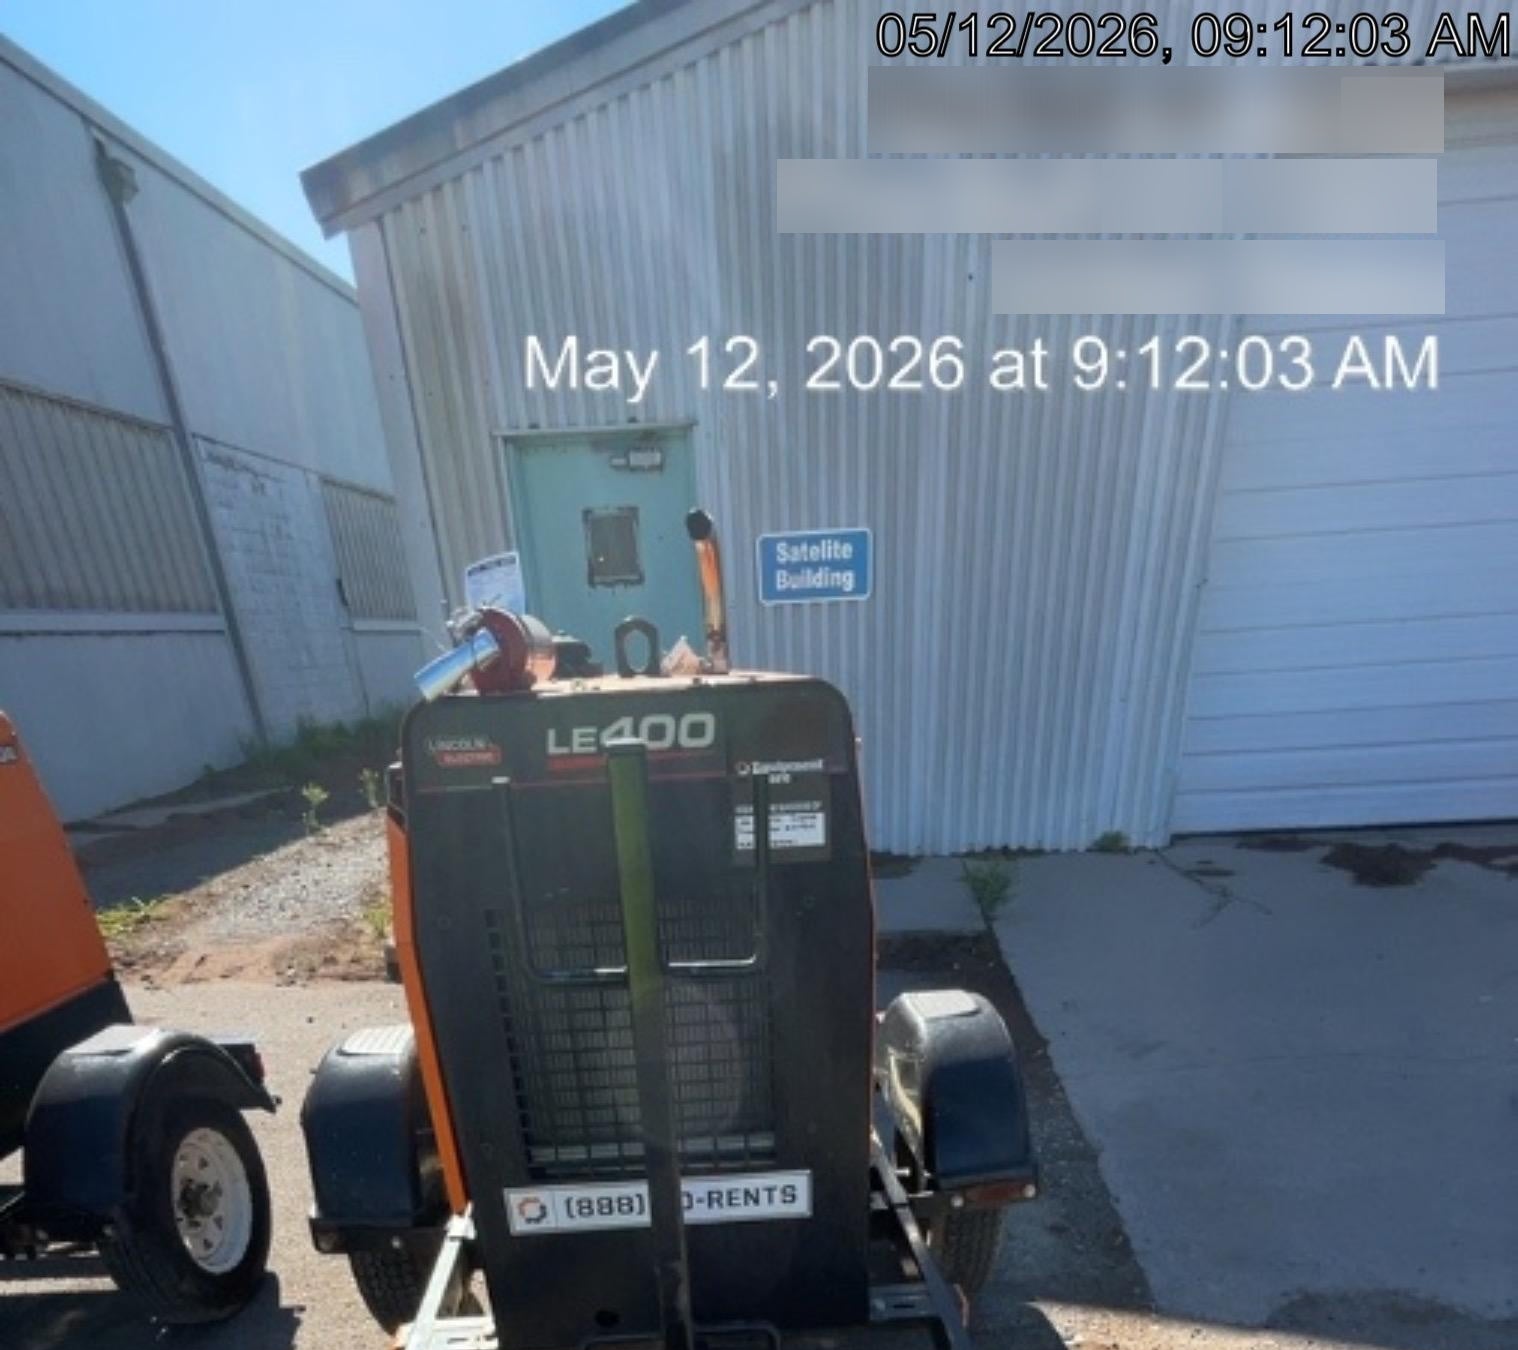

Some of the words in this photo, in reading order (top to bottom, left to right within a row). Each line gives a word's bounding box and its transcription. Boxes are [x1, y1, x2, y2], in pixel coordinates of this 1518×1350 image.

[775, 538, 854, 564] Satelite
[775, 566, 856, 592] Building
[547, 712, 716, 755] LE400
[565, 1192, 646, 1220] (888)
